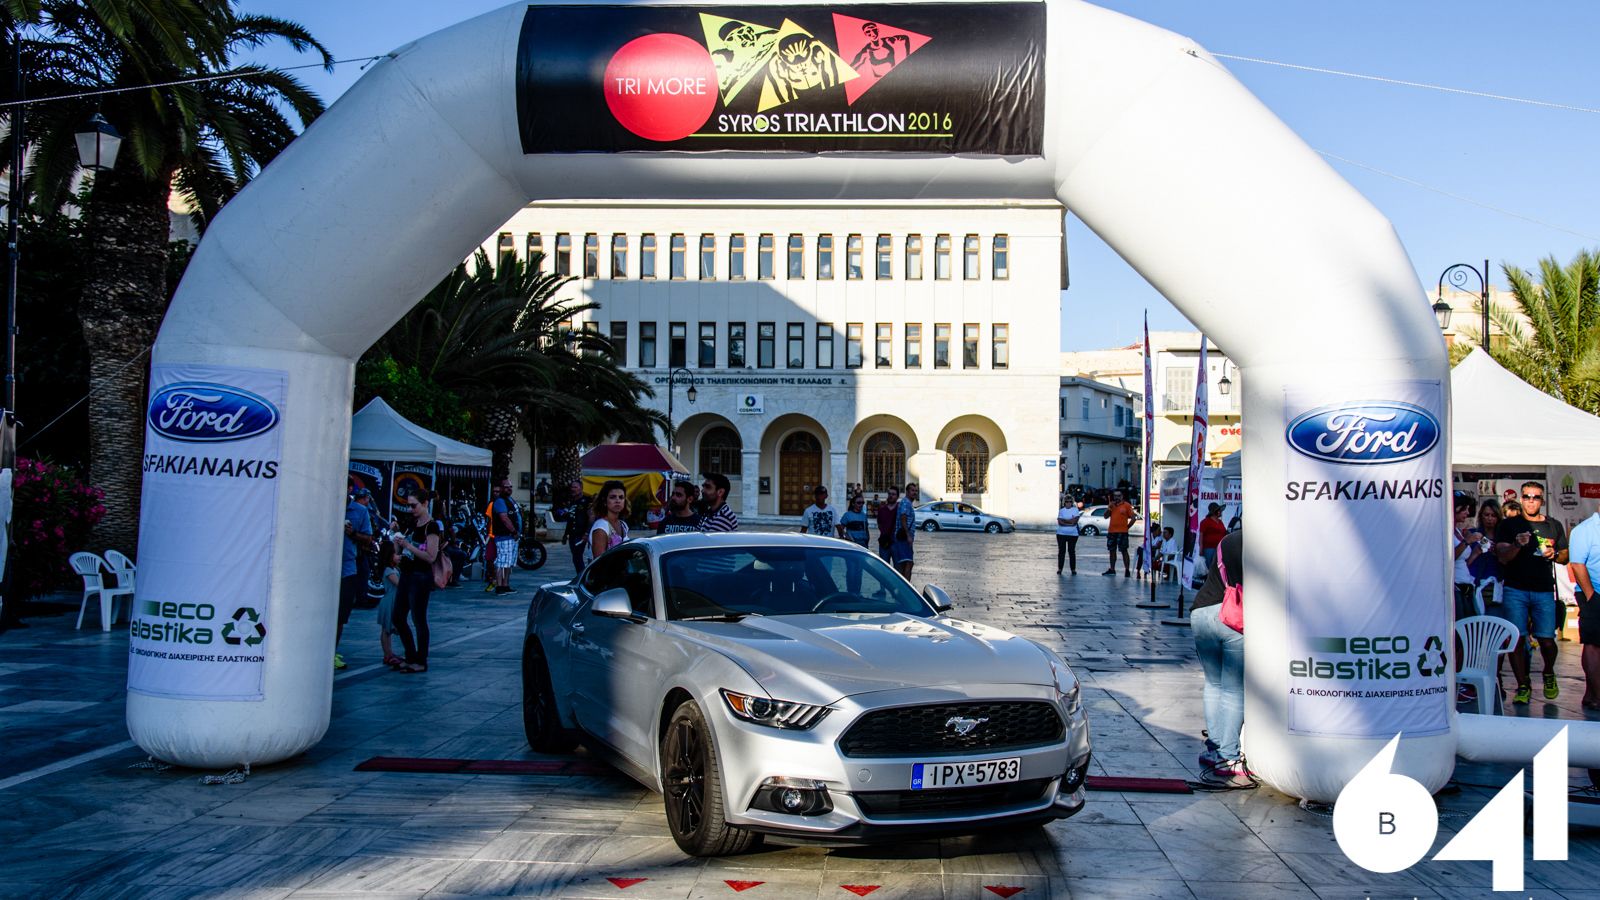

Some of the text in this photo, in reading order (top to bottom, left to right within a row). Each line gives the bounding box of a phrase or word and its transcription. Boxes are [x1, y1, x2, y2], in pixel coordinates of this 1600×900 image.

[615, 77, 706, 95] TRI MORE
[718, 112, 952, 133] SYROS TRIATHLON 2016
[159, 391, 249, 433] Ford
[1316, 412, 1419, 454] Ford
[144, 454, 279, 479] SFAKIANAKIS
[1285, 478, 1443, 501] SFAKIANAKIS
[162, 602, 215, 621] eco
[131, 618, 214, 645] elastika
[1350, 635, 1410, 655] eco
[168, 653, 215, 662] ΔΙΑΧΕΙΡΙΣΗΣ
[217, 655, 265, 663] ΕΛΑΣΤΙΚΩΝ
[1289, 657, 1411, 680] elastika
[1306, 688, 1364, 698] ΟΙΚΟΛΟΓΙΚΗΣ
[1365, 688, 1414, 698] ΔΙΑΧΕΙΡΙΣΗΣ
[1415, 685, 1448, 696] ΕΛΑΣΤΙΚΩΝ
